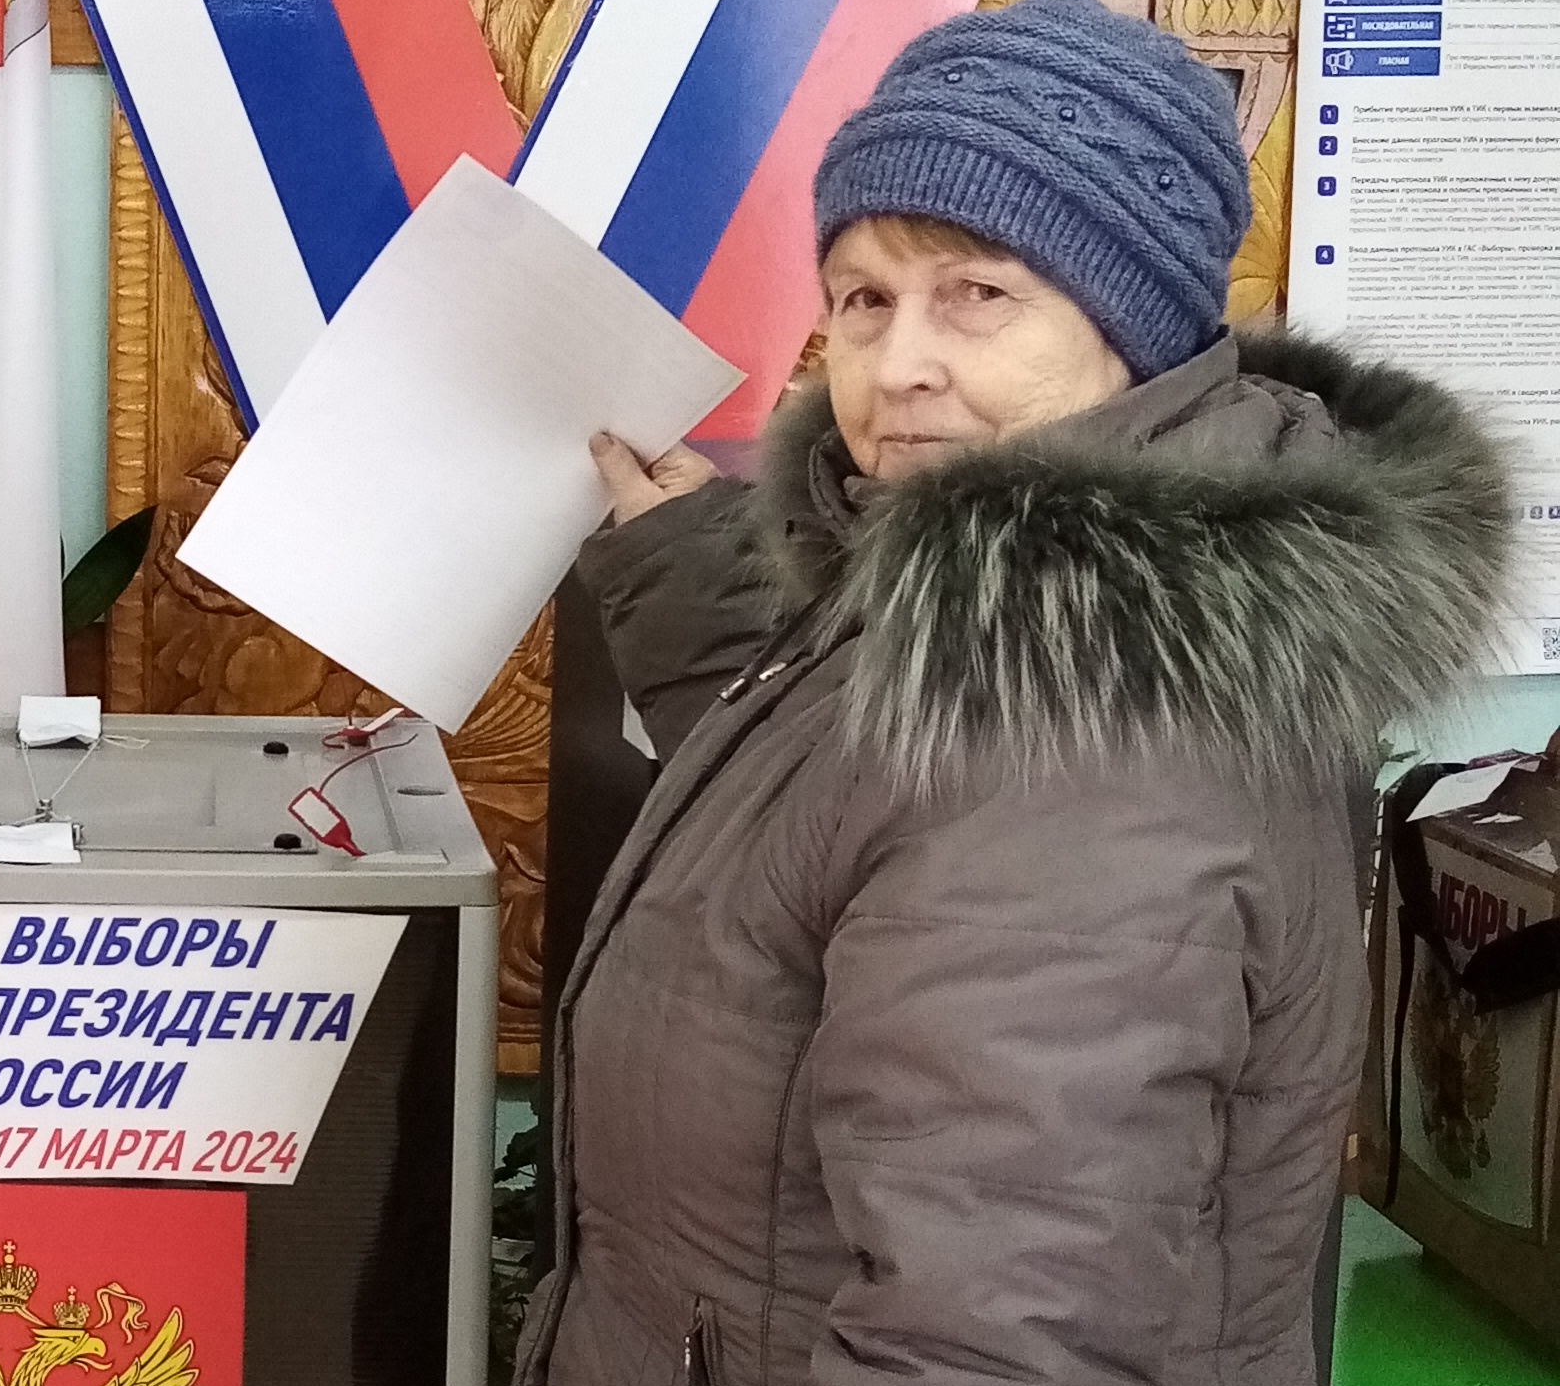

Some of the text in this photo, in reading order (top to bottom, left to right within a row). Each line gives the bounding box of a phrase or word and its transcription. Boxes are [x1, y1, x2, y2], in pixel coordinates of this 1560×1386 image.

[1325, 110, 1332, 119] 1
[1324, 141, 1332, 150] 2
[1321, 250, 1329, 259] 4
[0, 915, 277, 969] ВЫБОРЫ
[39, 1128, 187, 1173] МАРТА
[192, 1130, 298, 1175] 2024
